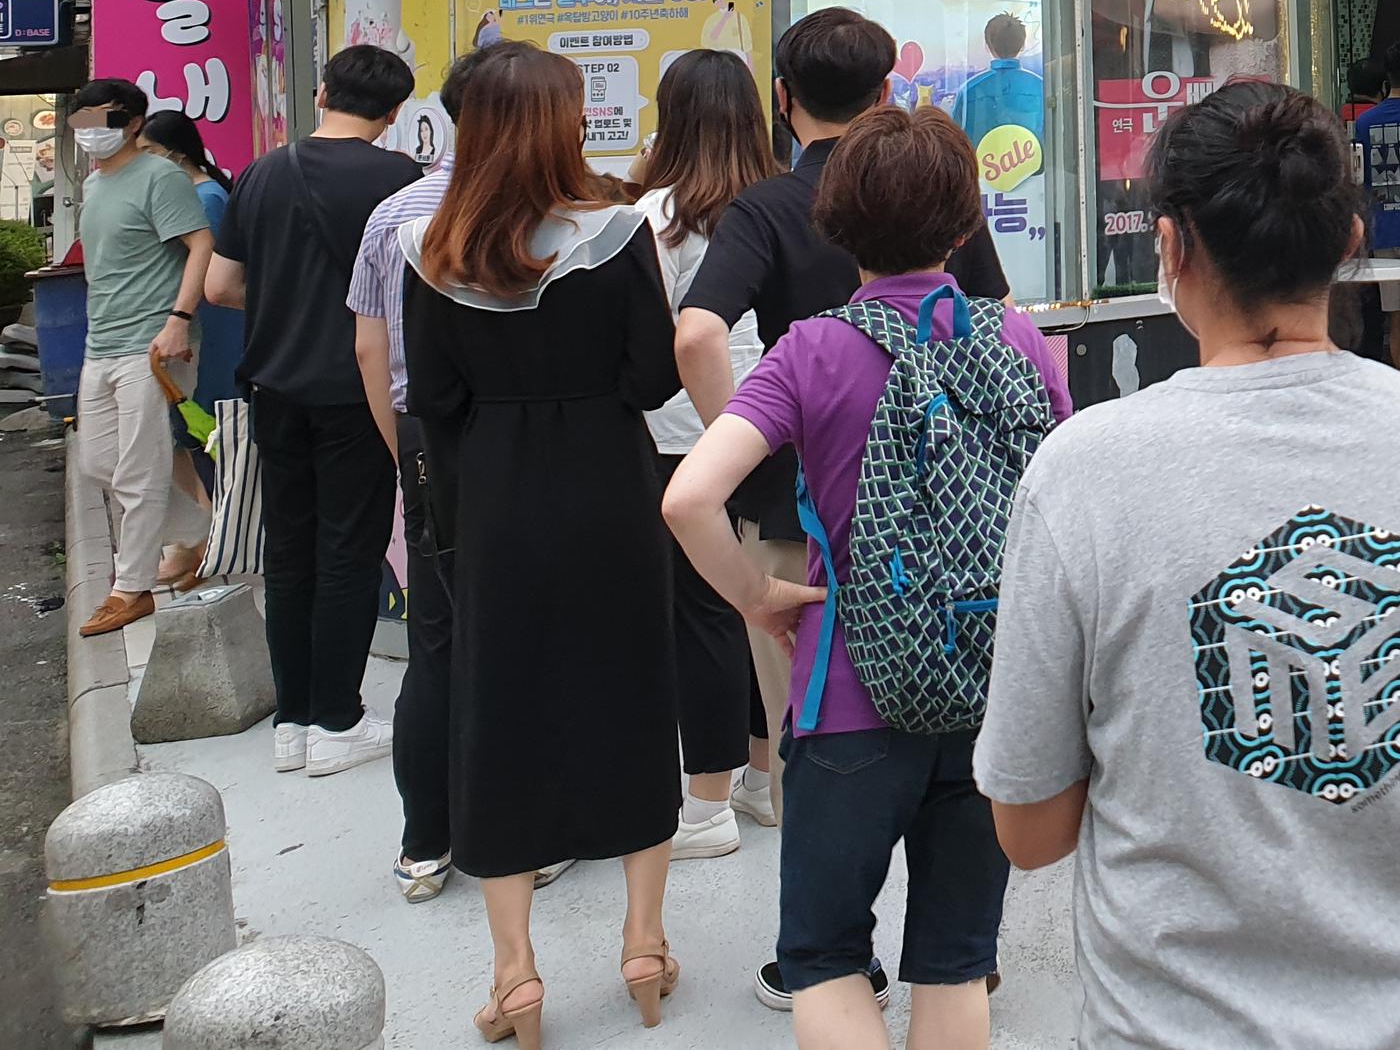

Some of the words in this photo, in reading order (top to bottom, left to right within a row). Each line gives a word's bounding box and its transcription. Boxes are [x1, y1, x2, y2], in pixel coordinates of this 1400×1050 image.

[560, 36, 589, 48] 이벤트
[607, 63, 620, 73] 02
[1112, 118, 1133, 133] 연극
[982, 139, 1034, 182] Sale
